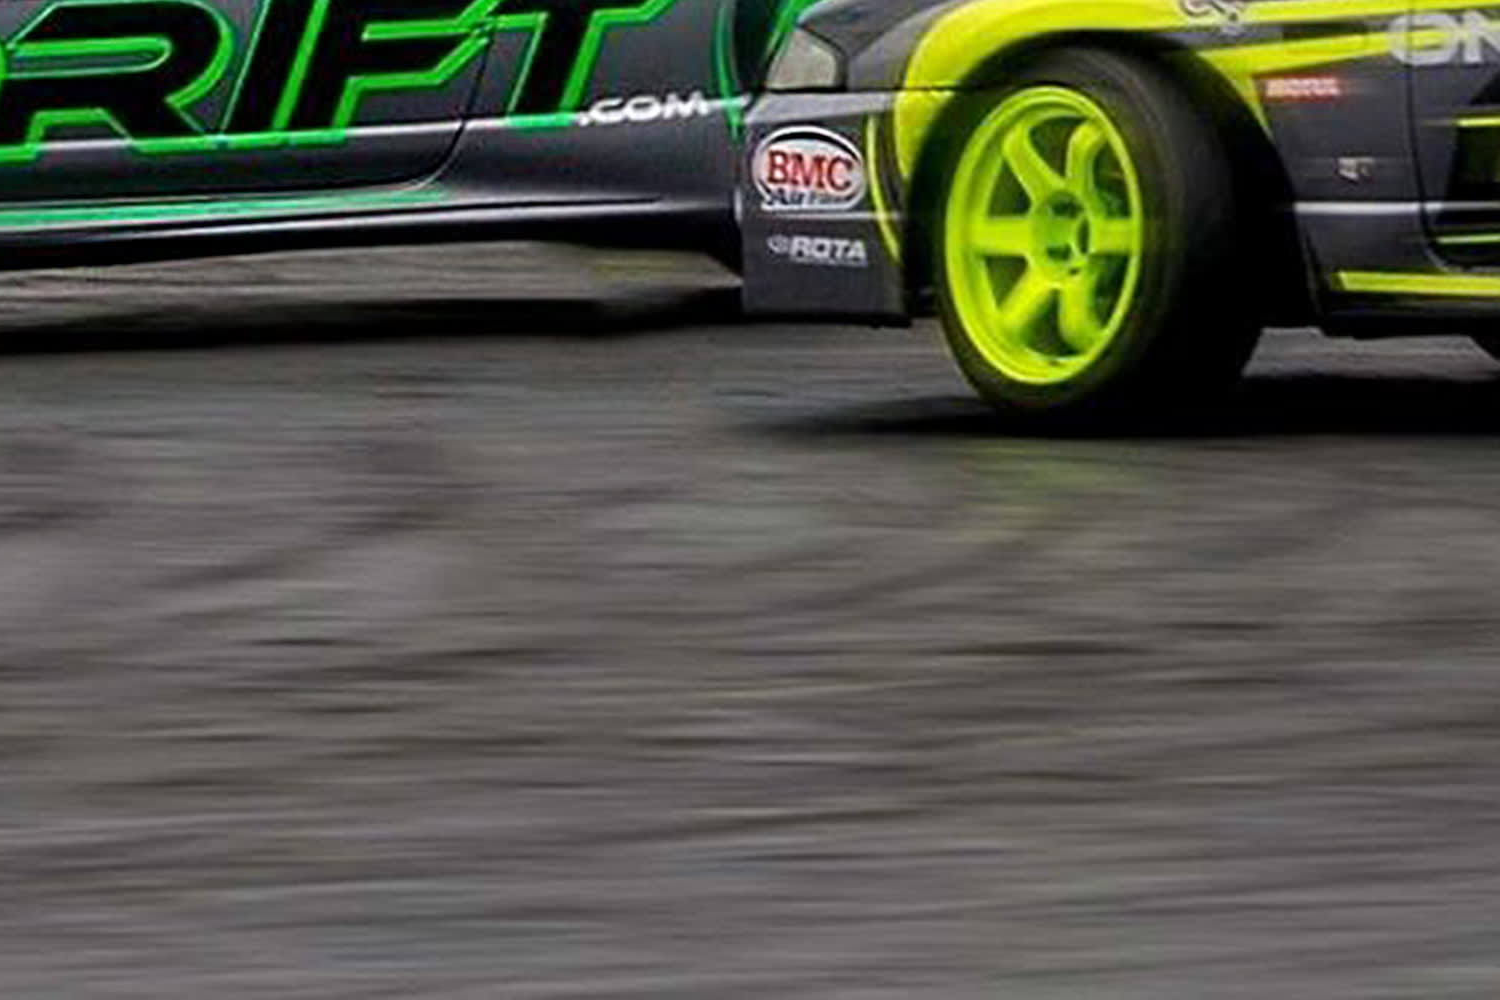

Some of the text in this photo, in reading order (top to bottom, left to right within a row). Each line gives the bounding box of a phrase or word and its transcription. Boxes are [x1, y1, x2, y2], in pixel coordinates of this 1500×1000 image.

[578, 90, 708, 126] .COM
[766, 150, 853, 191] BMC
[790, 235, 867, 266] ROTA
